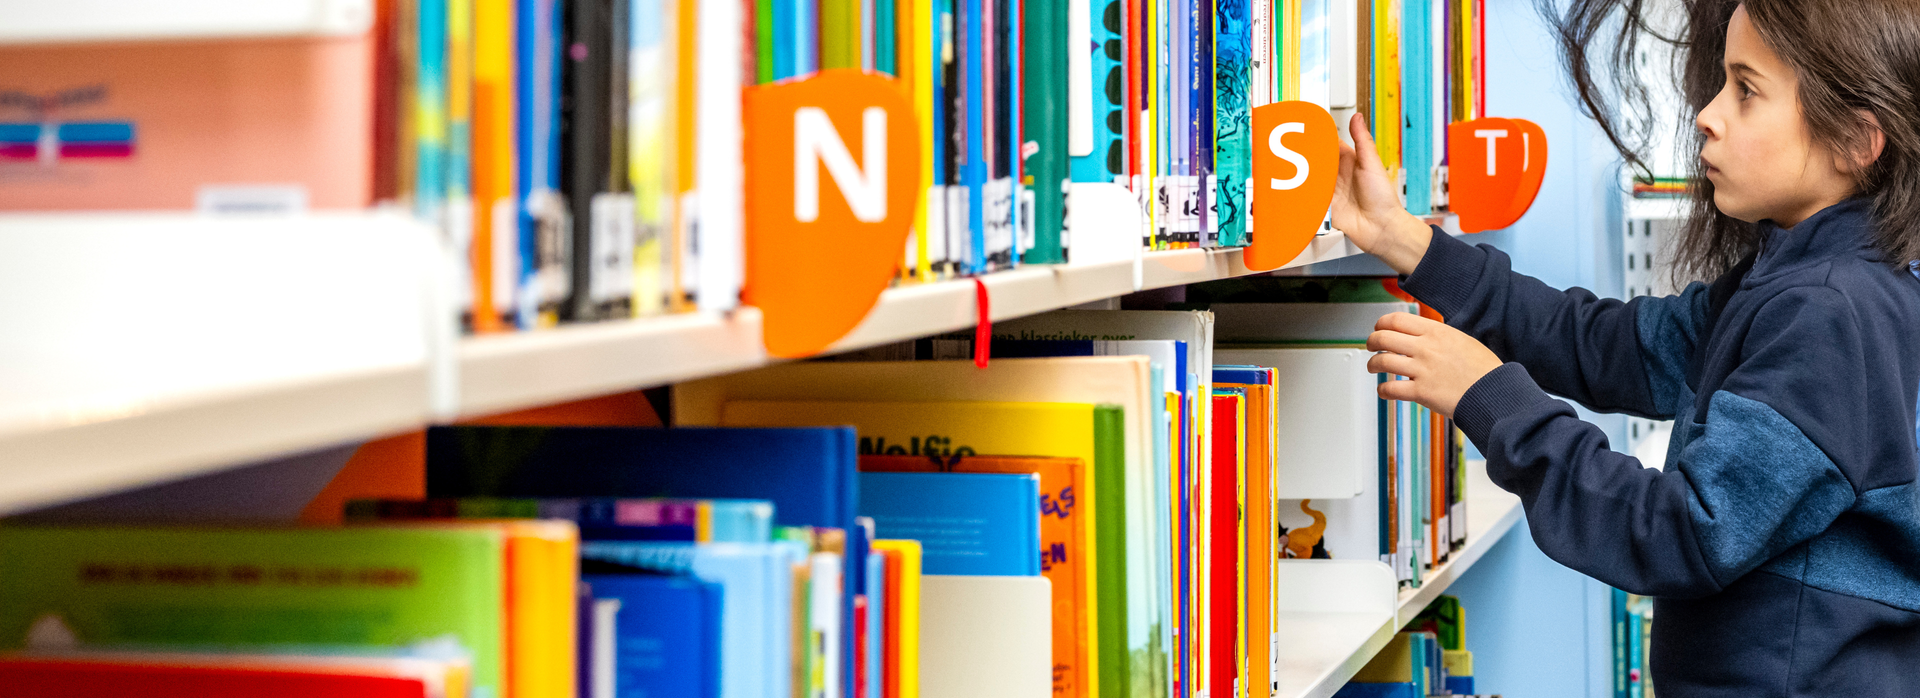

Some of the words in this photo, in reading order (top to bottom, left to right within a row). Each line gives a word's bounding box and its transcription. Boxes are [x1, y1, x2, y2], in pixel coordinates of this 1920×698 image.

[793, 106, 888, 223] N
[1268, 122, 1310, 190] S
[1474, 129, 1508, 176] T
